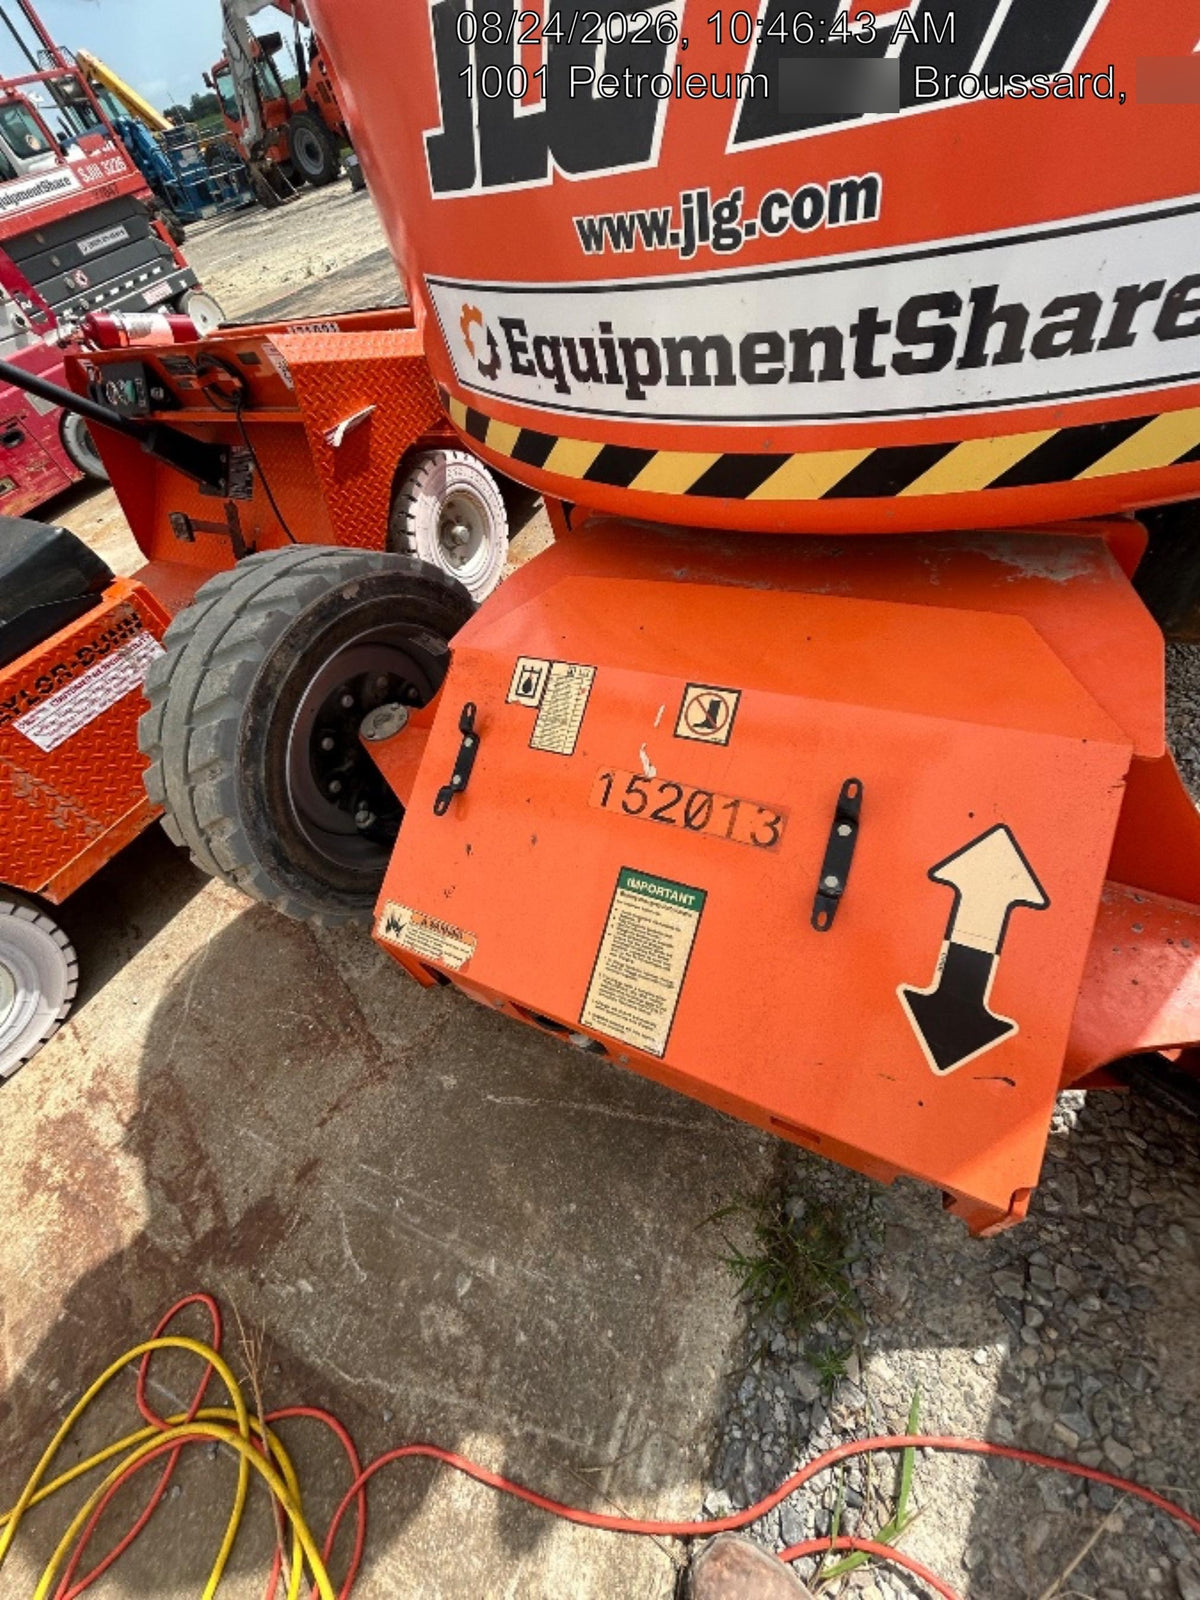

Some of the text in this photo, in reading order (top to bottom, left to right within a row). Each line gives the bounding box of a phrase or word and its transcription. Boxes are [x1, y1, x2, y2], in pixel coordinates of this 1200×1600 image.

[574, 174, 880, 258] www.jlg.com
[497, 273, 1200, 400] EquipmentShare
[600, 771, 783, 849] 152013
[626, 877, 696, 906] IMPORTANT
